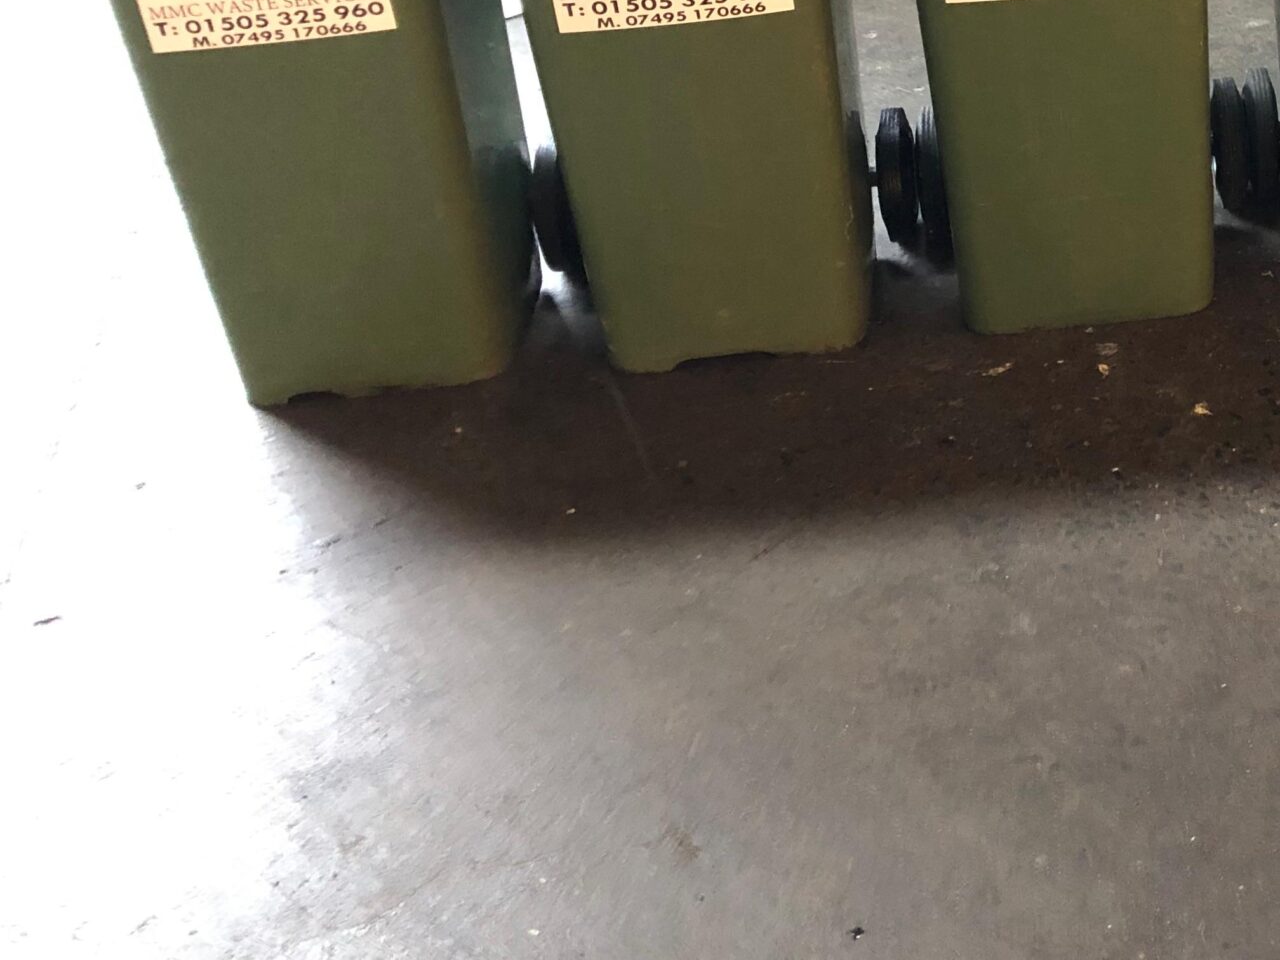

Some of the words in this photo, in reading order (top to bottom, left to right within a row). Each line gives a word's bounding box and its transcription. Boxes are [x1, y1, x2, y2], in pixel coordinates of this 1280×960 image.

[148, 3, 201, 21] MMC
[154, 22, 179, 37] T:
[185, 13, 269, 34] 01505
[279, 7, 326, 26] 325
[334, 1, 384, 20] 960
[562, 2, 585, 17] T:
[597, 17, 621, 28] M.
[626, 10, 686, 26] 07495
[694, 1, 766, 19] 170666
[192, 37, 217, 48] M.
[222, 29, 285, 45] 07495
[294, 21, 367, 38] 170666
